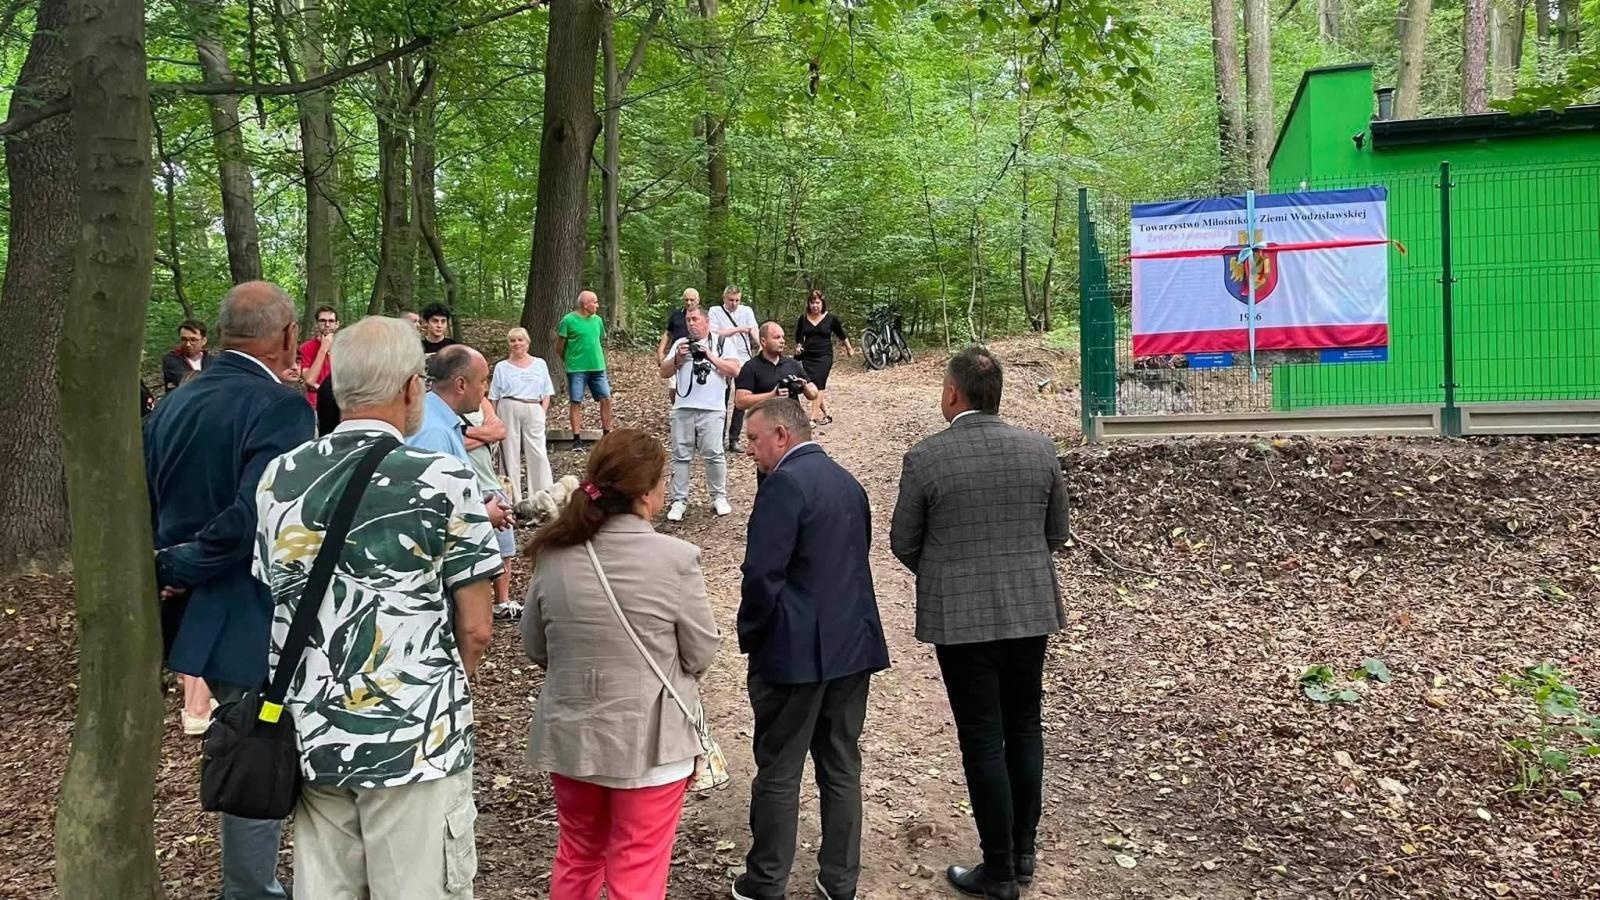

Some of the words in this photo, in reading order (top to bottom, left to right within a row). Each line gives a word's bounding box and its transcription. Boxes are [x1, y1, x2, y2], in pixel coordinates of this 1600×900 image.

[1140, 221, 1199, 232] Towarzystwo
[1203, 216, 1256, 227] Miłośnikó
[1260, 214, 1288, 223] Ziemi
[1290, 208, 1367, 220] Wodzisławskiej
[1240, 312, 1262, 322] 196
